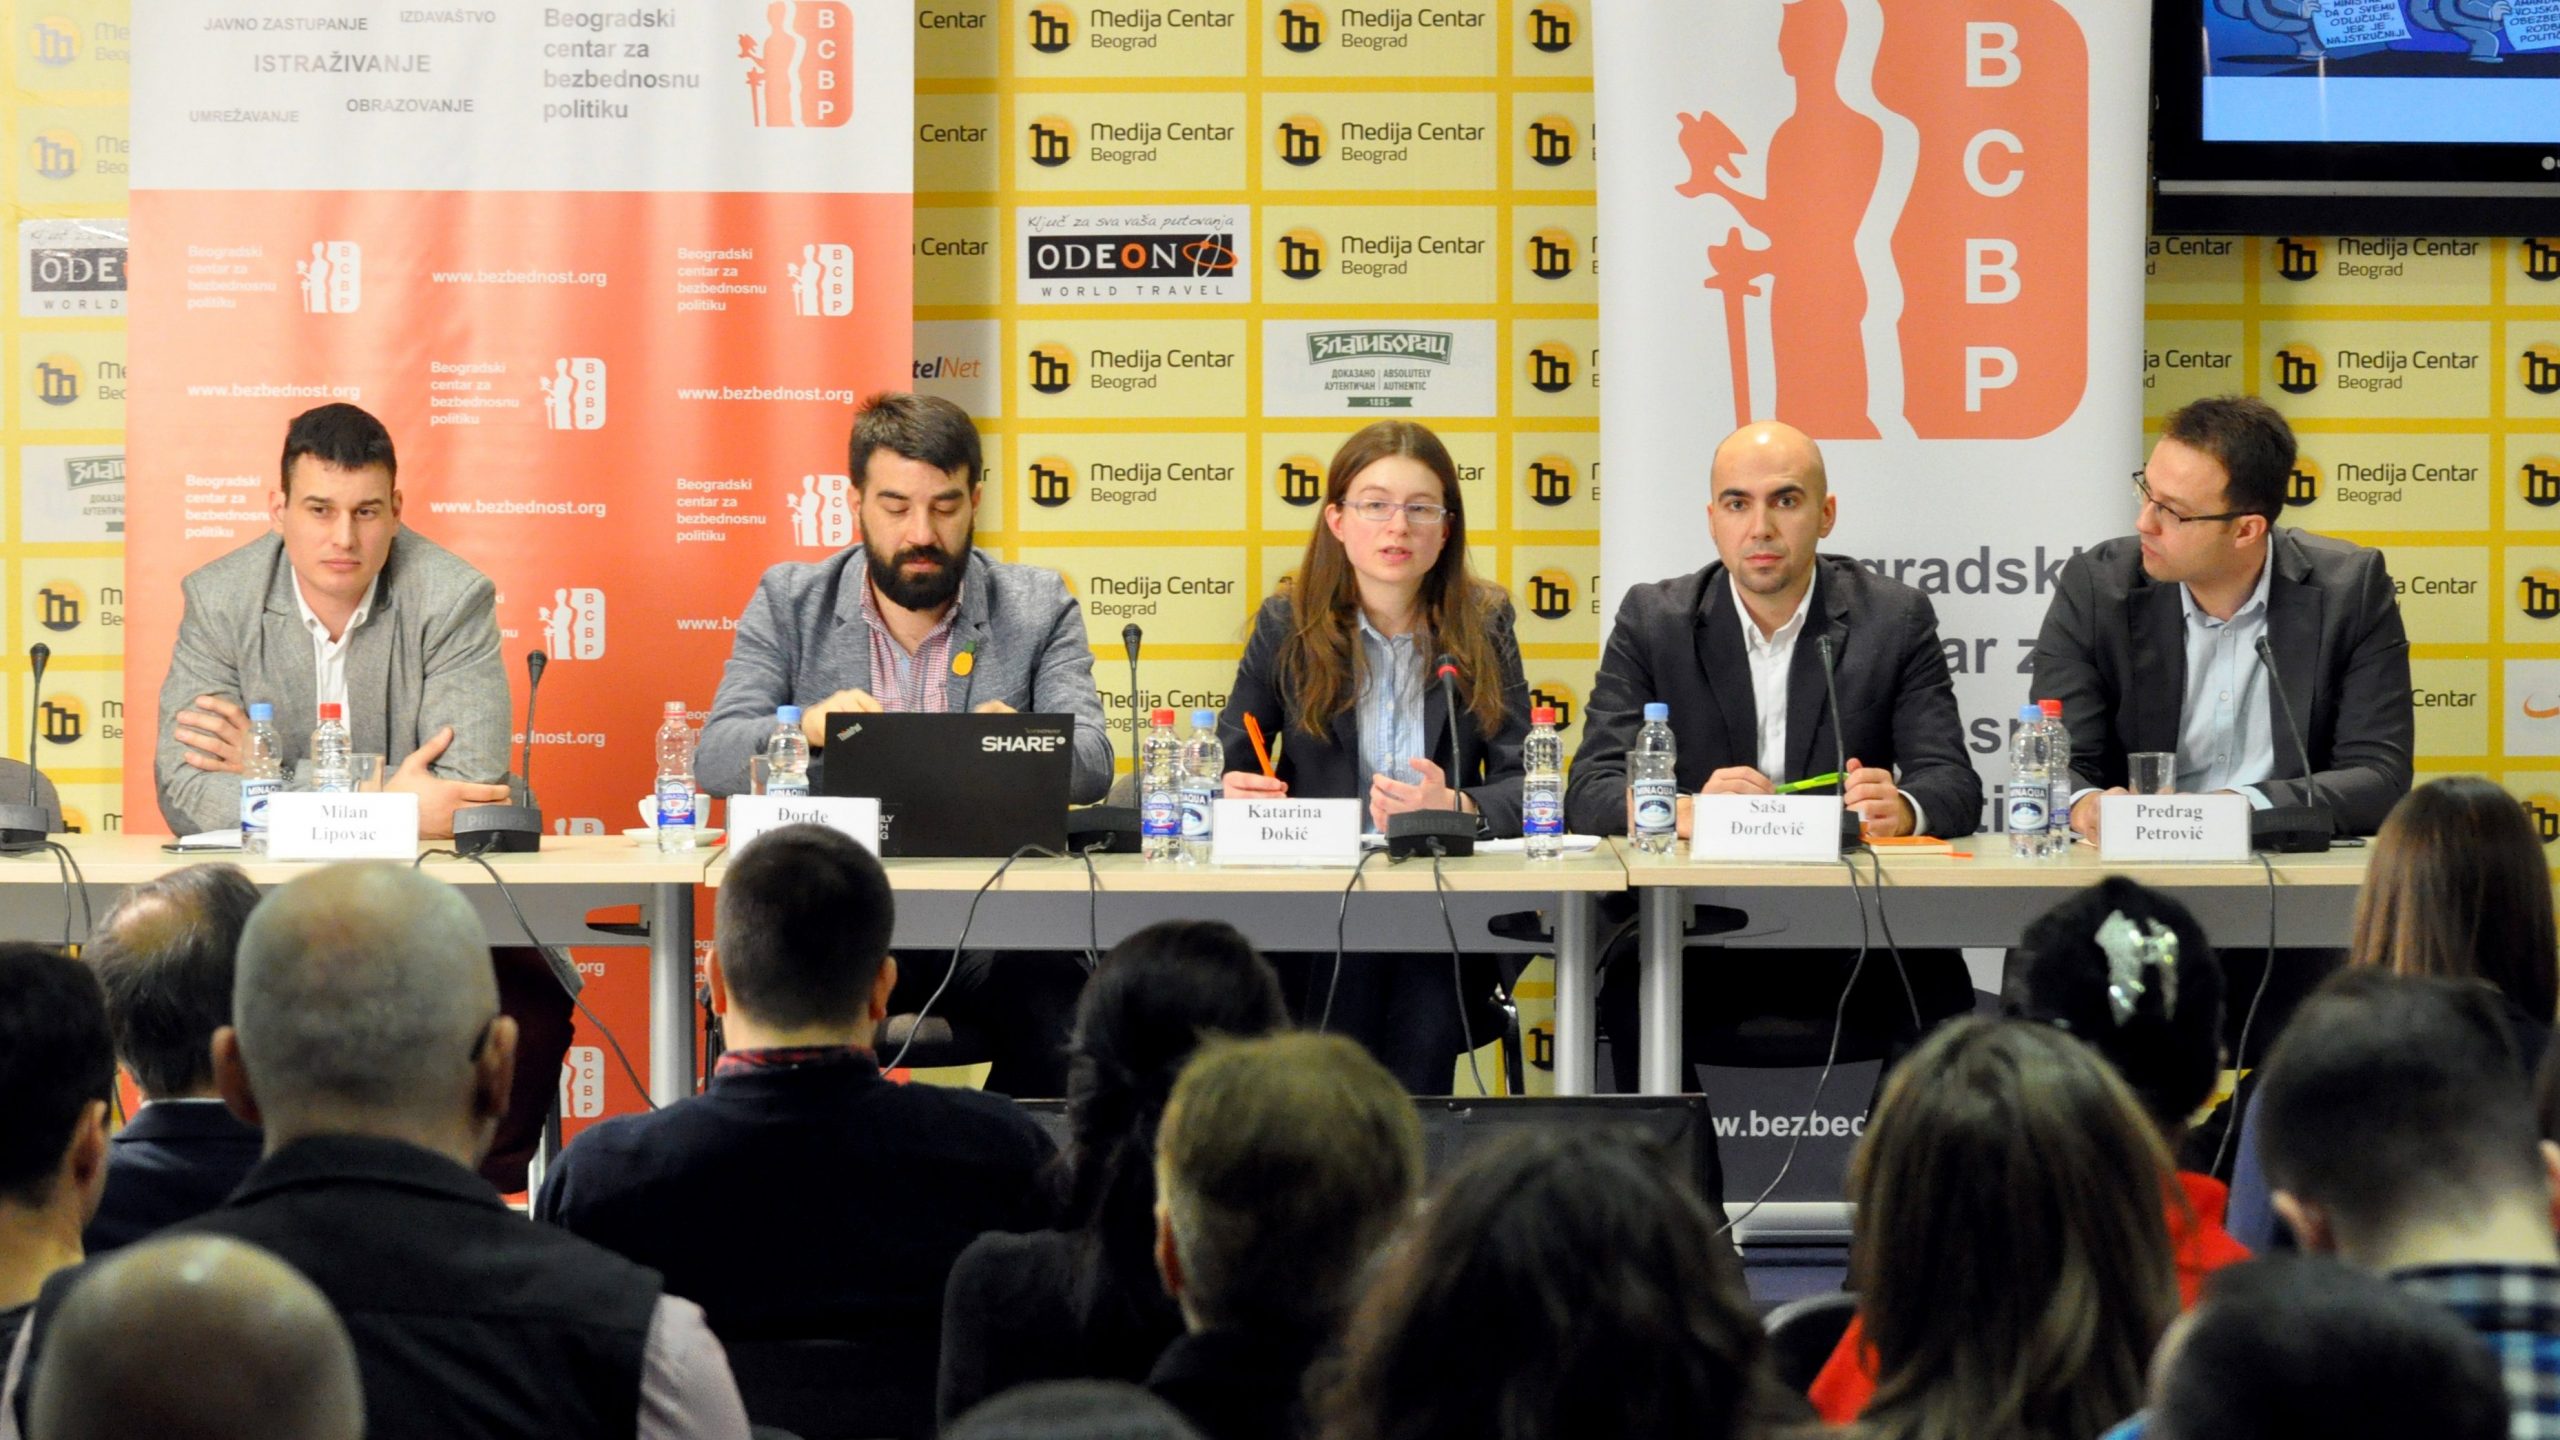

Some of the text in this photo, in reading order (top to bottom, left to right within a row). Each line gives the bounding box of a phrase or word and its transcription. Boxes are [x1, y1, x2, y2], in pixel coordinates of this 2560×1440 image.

[400, 9, 496, 24] IZDAVAŠTVO
[2359, 3, 2395, 14] SVEMU
[203, 17, 368, 32] JAVNO ZASTUPANJE
[544, 7, 676, 33] Beogradski
[920, 10, 987, 28] Centar
[1090, 9, 1235, 32] Medija Centar
[1341, 9, 1485, 32] Medija Centar
[2343, 22, 2385, 34] JER JE
[544, 40, 650, 59] centar za
[1090, 34, 1157, 51] Beograd
[1341, 34, 1408, 50] Beograd
[253, 50, 431, 74] ISTRAŽIVANJE
[544, 68, 699, 89] bezbednosnu
[346, 98, 474, 114] OBRAZOVANJE
[543, 99, 629, 123] politiku
[189, 108, 299, 123] UMREŽAVANJE
[920, 124, 987, 143] Centar
[1090, 122, 1235, 145] Medija Centar
[1341, 122, 1485, 145] Medija Centar
[1090, 148, 1157, 164] Beograd
[1341, 147, 1408, 164] Beograd
[1073, 218, 1089, 228] za
[1096, 217, 1121, 227] sva
[921, 237, 988, 256] Centar
[1341, 236, 1485, 258] Medija Centar
[2165, 236, 2232, 255] Centar
[2338, 237, 2478, 260] Medija Centar
[678, 248, 752, 262] Beogradski
[1037, 242, 1178, 270] ODEON
[39, 257, 126, 283] ODE
[678, 266, 738, 277] centar za
[1341, 260, 1408, 277] Beograd
[2338, 262, 2403, 278] Beograd
[432, 270, 607, 287] www.bezbednost.org
[678, 282, 766, 294] bezbednosnu
[1042, 285, 1223, 297] WORLD TRAVEL
[678, 299, 726, 313] politiku
[912, 356, 981, 379] telNet
[1090, 350, 1235, 372] Medija Centar
[2165, 350, 2232, 369] Centar
[2338, 350, 2478, 373] Medija Centar
[431, 361, 506, 376] Beogradski
[1331, 369, 1375, 379] ДОКАЗАНО
[1383, 369, 1431, 378] ABSOLUTELY
[187, 383, 360, 400] www.bezbednost.org
[431, 379, 492, 391] centar za
[1090, 375, 1157, 392] Beograd
[1383, 381, 1427, 391] AUTHENTIC
[2338, 375, 2403, 392] Beograd
[431, 396, 520, 408] bezbednosnu
[677, 386, 853, 404] www.bezbednost.org
[431, 413, 480, 427] politiku
[1090, 462, 1235, 485] Medija Centar
[2338, 464, 2478, 486] Medija Centar
[676, 478, 752, 492] Beogradski
[676, 496, 737, 508] centar za
[1090, 488, 1157, 504] Beograd
[2338, 488, 2402, 505] Beograd
[431, 500, 606, 518] www.bezbednost.org
[676, 513, 765, 525] bezbednosnu
[676, 530, 725, 544] politiku
[1090, 576, 1235, 598] Medija Centar
[2411, 576, 2478, 594] Centar
[1090, 601, 1157, 618] Beograd
[1167, 690, 1226, 708] Centa
[2411, 689, 2477, 708] Centar
[981, 736, 1055, 752] SHARE
[321, 804, 369, 819] Milan
[1247, 804, 1323, 820] Katarina
[1750, 799, 1787, 814] Saša
[2136, 803, 2204, 820] Predrag
[312, 827, 377, 844] Lipovac
[1260, 825, 1310, 842] Đokić
[2136, 825, 2204, 841] Petrović
